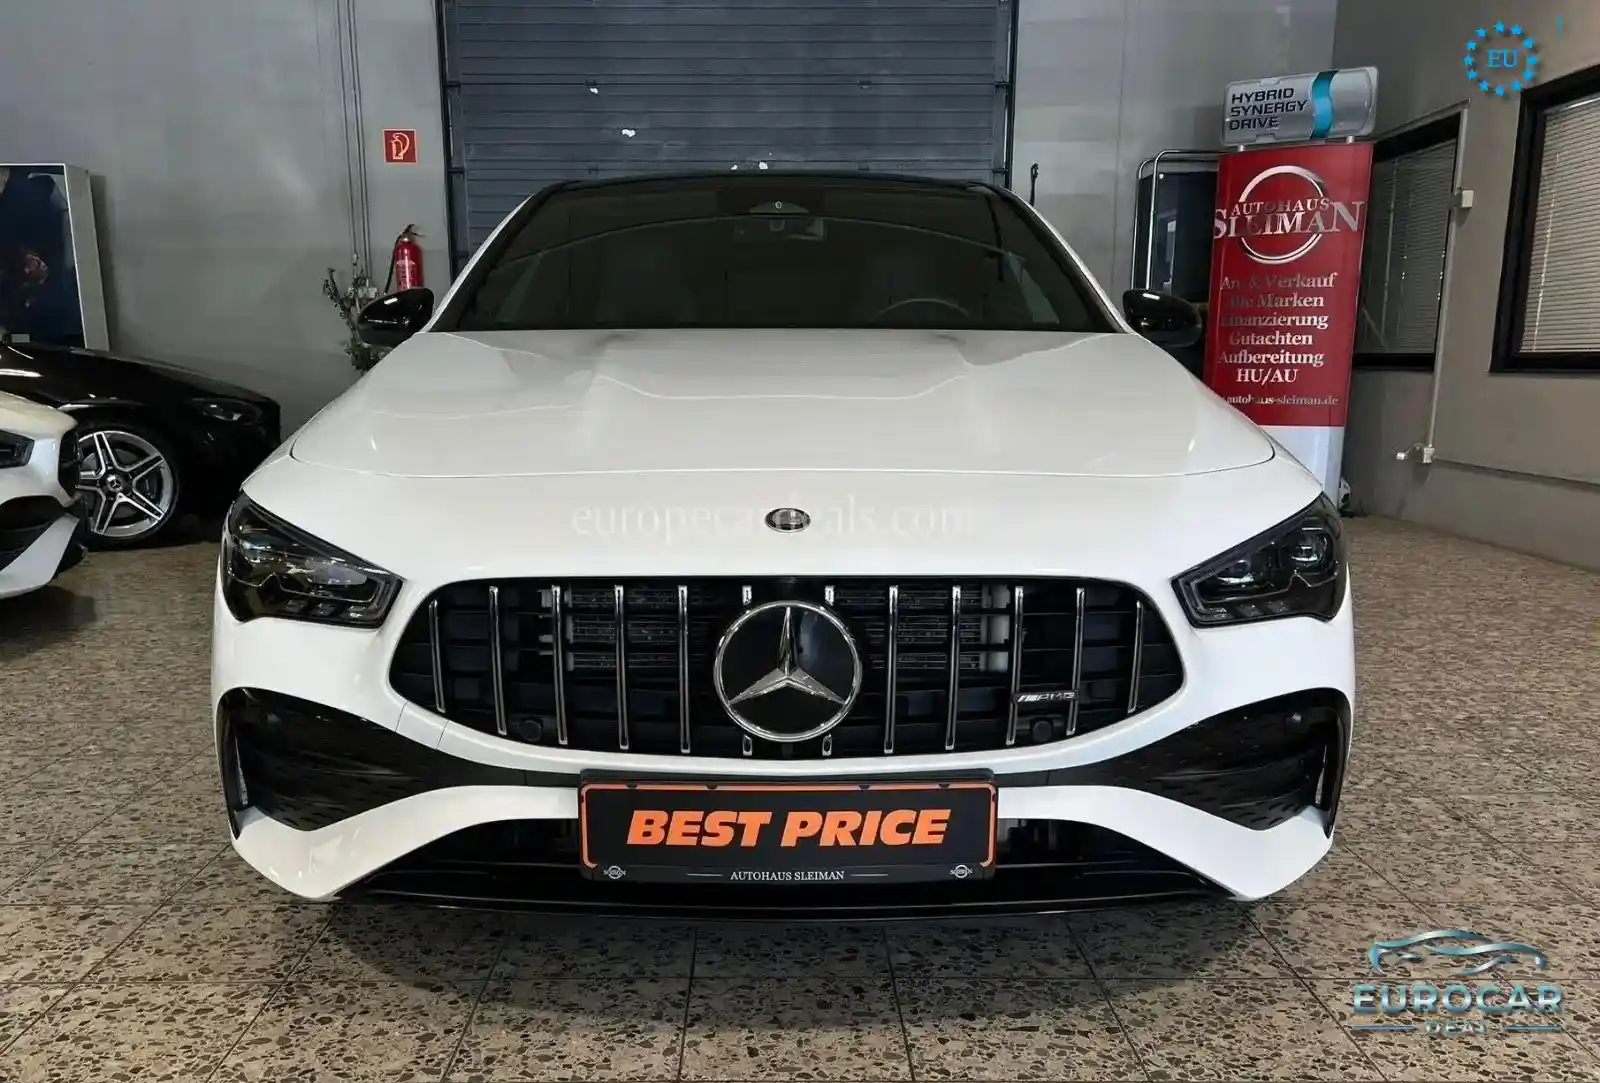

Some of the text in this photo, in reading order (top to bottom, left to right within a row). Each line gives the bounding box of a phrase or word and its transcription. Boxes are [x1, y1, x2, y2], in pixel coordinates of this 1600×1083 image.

[1231, 87, 1295, 104] HYBRID
[1229, 99, 1309, 118] SYNERGY
[1229, 116, 1280, 131] DRIVE
[1231, 197, 1331, 216] AUTOHAUS
[1213, 201, 1364, 239] SLEIMAN
[1265, 271, 1339, 289] Verkauf
[1257, 292, 1325, 308] Marken
[1229, 330, 1313, 346] Gutachten
[1218, 349, 1325, 368] Aufbereitung
[1236, 368, 1300, 386] HU/AU
[626, 809, 952, 848] BEST PRICE
[730, 870, 845, 881] AUTOHAUS SLEIMAN
